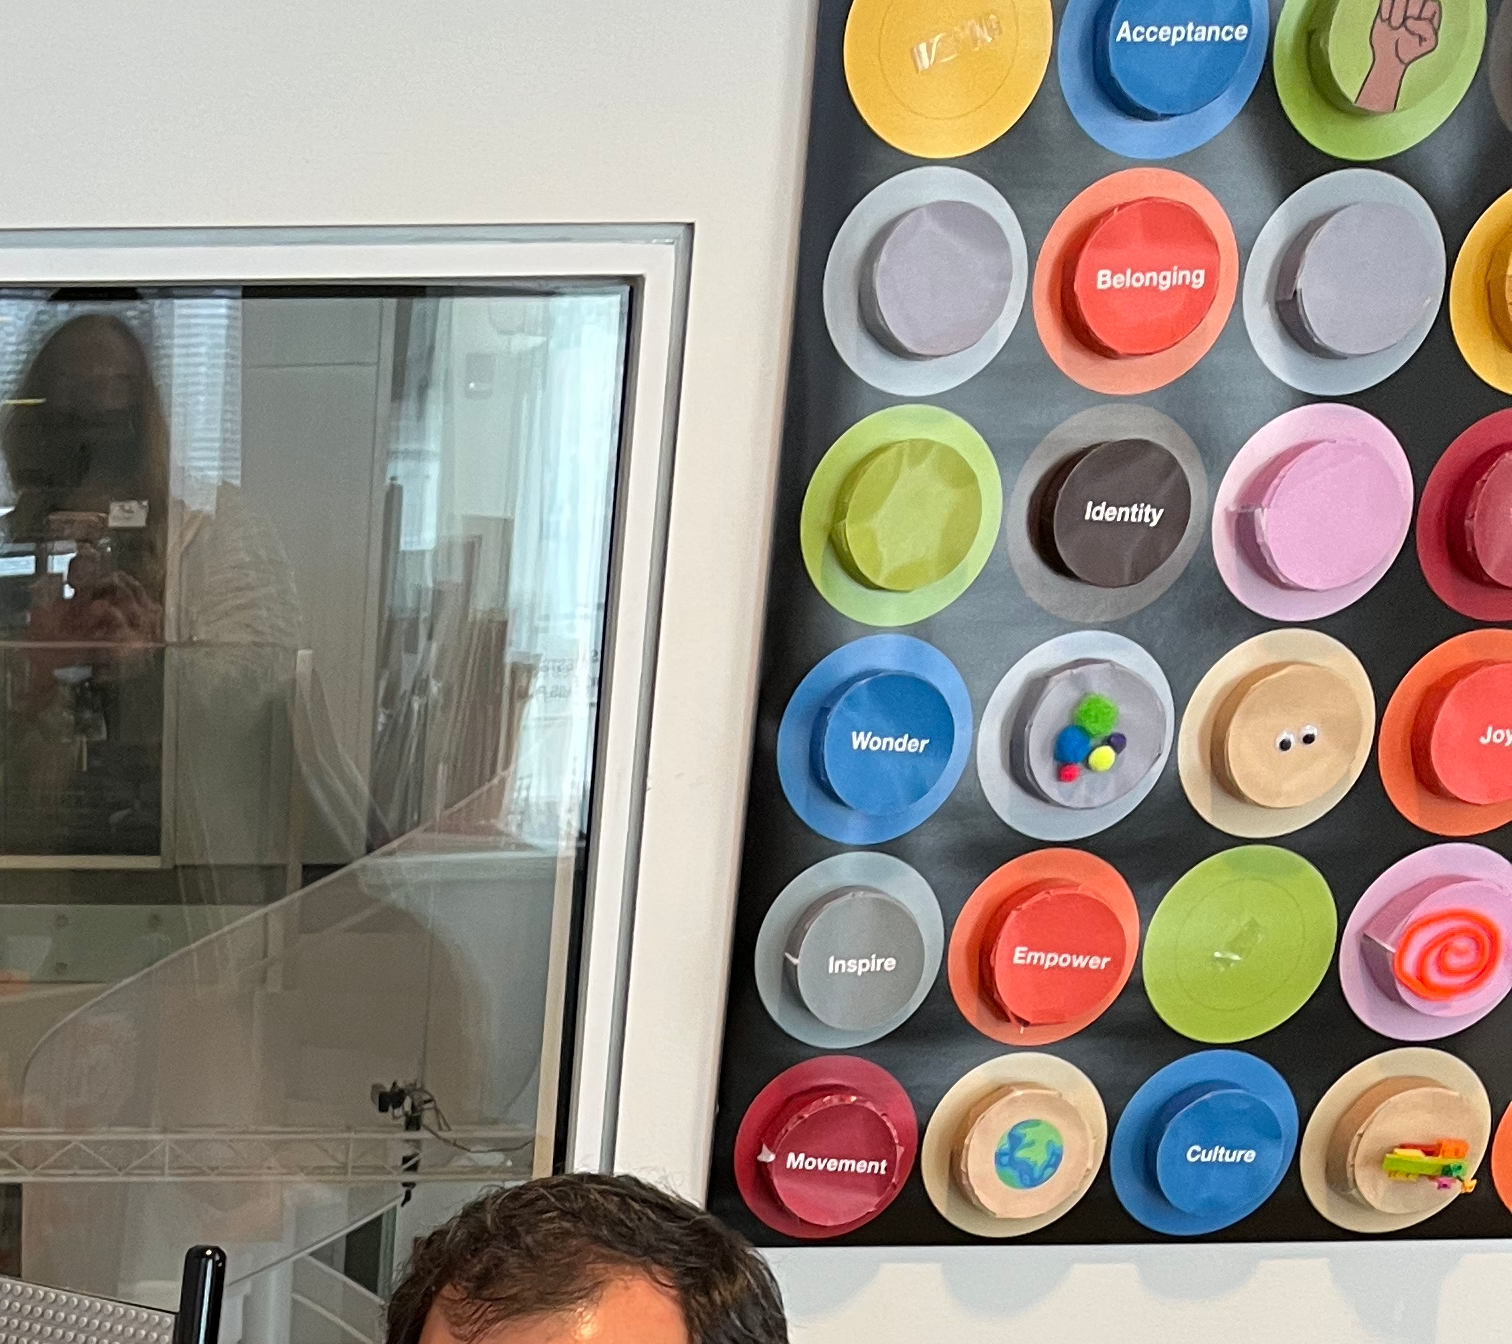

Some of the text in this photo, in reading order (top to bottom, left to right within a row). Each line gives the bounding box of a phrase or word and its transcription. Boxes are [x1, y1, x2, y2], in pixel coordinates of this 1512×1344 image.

[1115, 20, 1249, 47] Acceptance
[1096, 265, 1205, 291] Belonging
[1084, 500, 1165, 528] Identity
[851, 730, 930, 753] Wonder
[828, 953, 897, 977] Inspire
[1013, 946, 1111, 970] Empower
[786, 1152, 888, 1175] Movement
[1186, 1144, 1257, 1163] Culture
